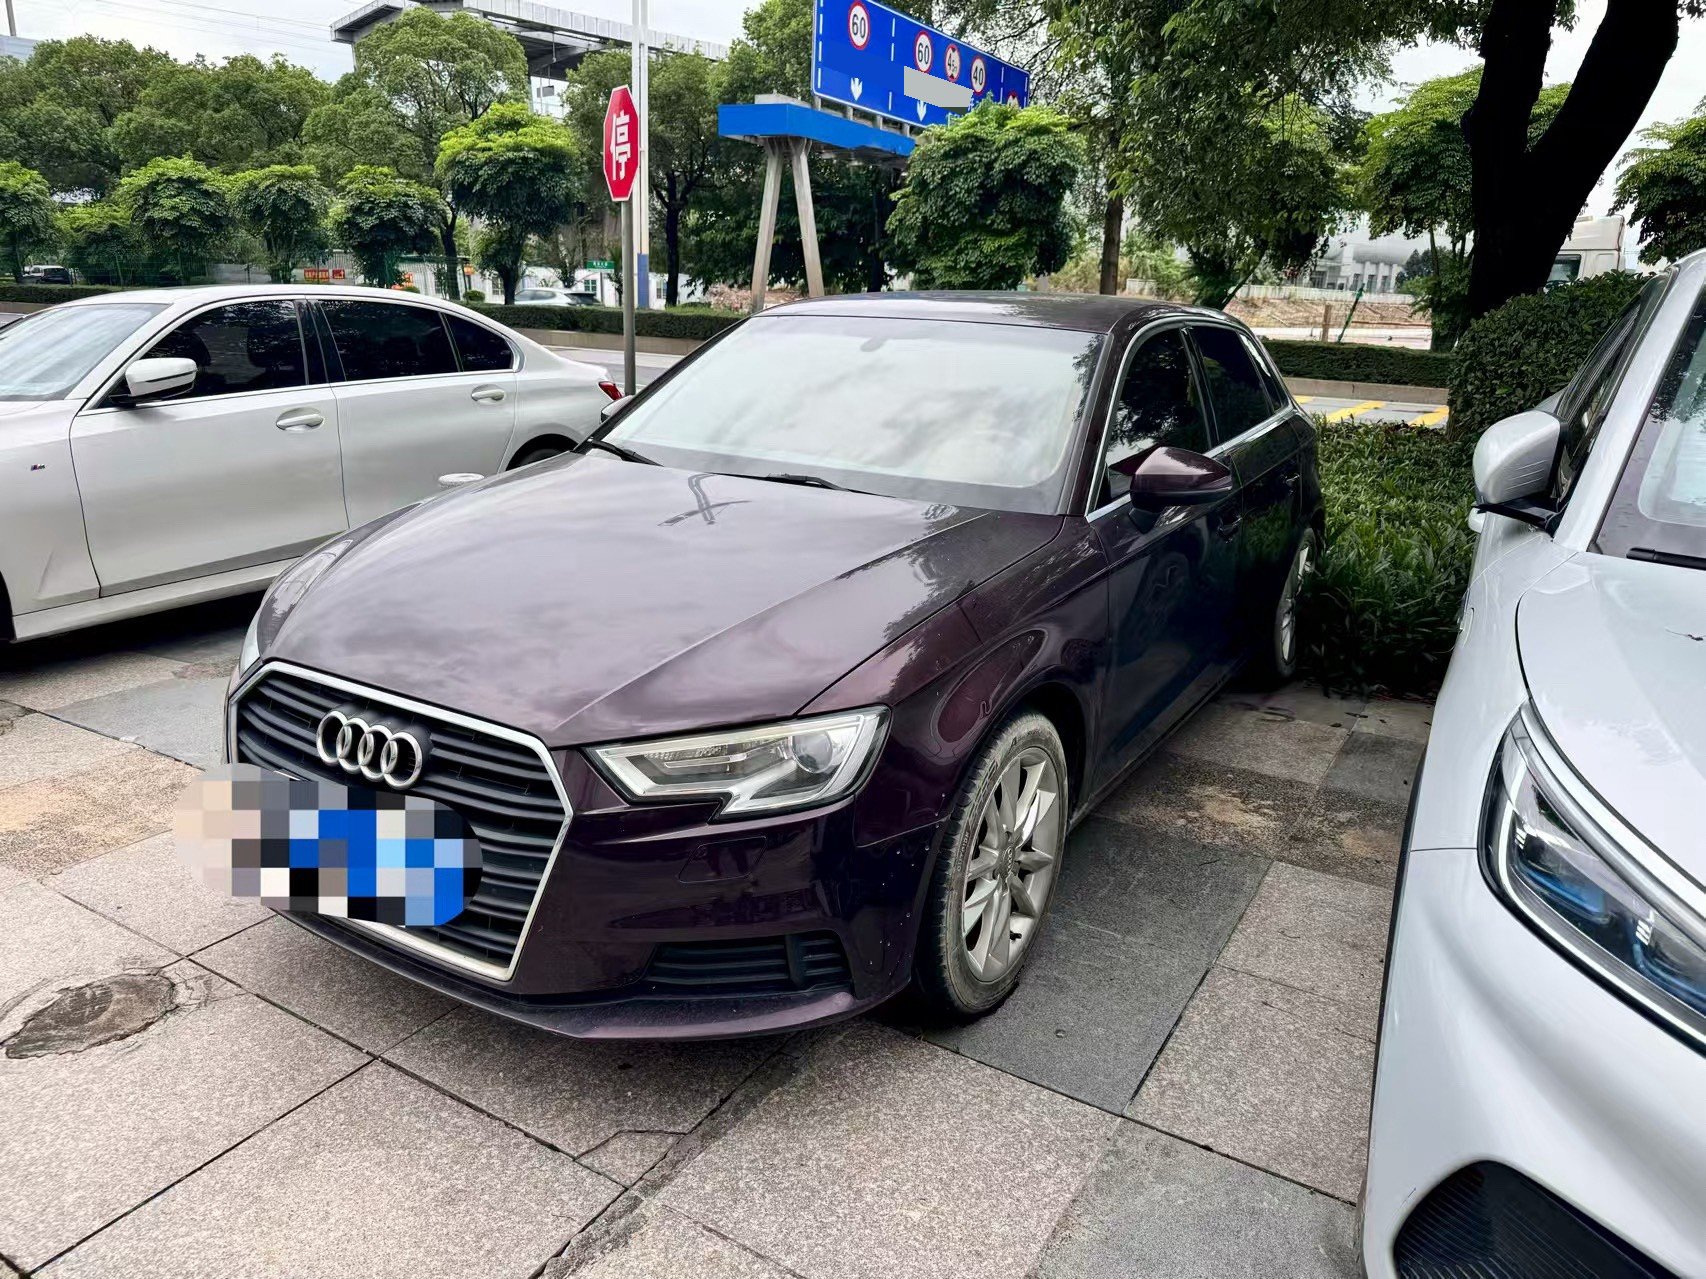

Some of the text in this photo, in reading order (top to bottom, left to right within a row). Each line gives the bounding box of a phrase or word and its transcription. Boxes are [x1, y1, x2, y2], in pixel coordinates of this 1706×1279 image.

[852, 13, 866, 38] 60
[918, 42, 930, 65] 60
[973, 65, 984, 86] 40
[609, 109, 632, 181] 停
